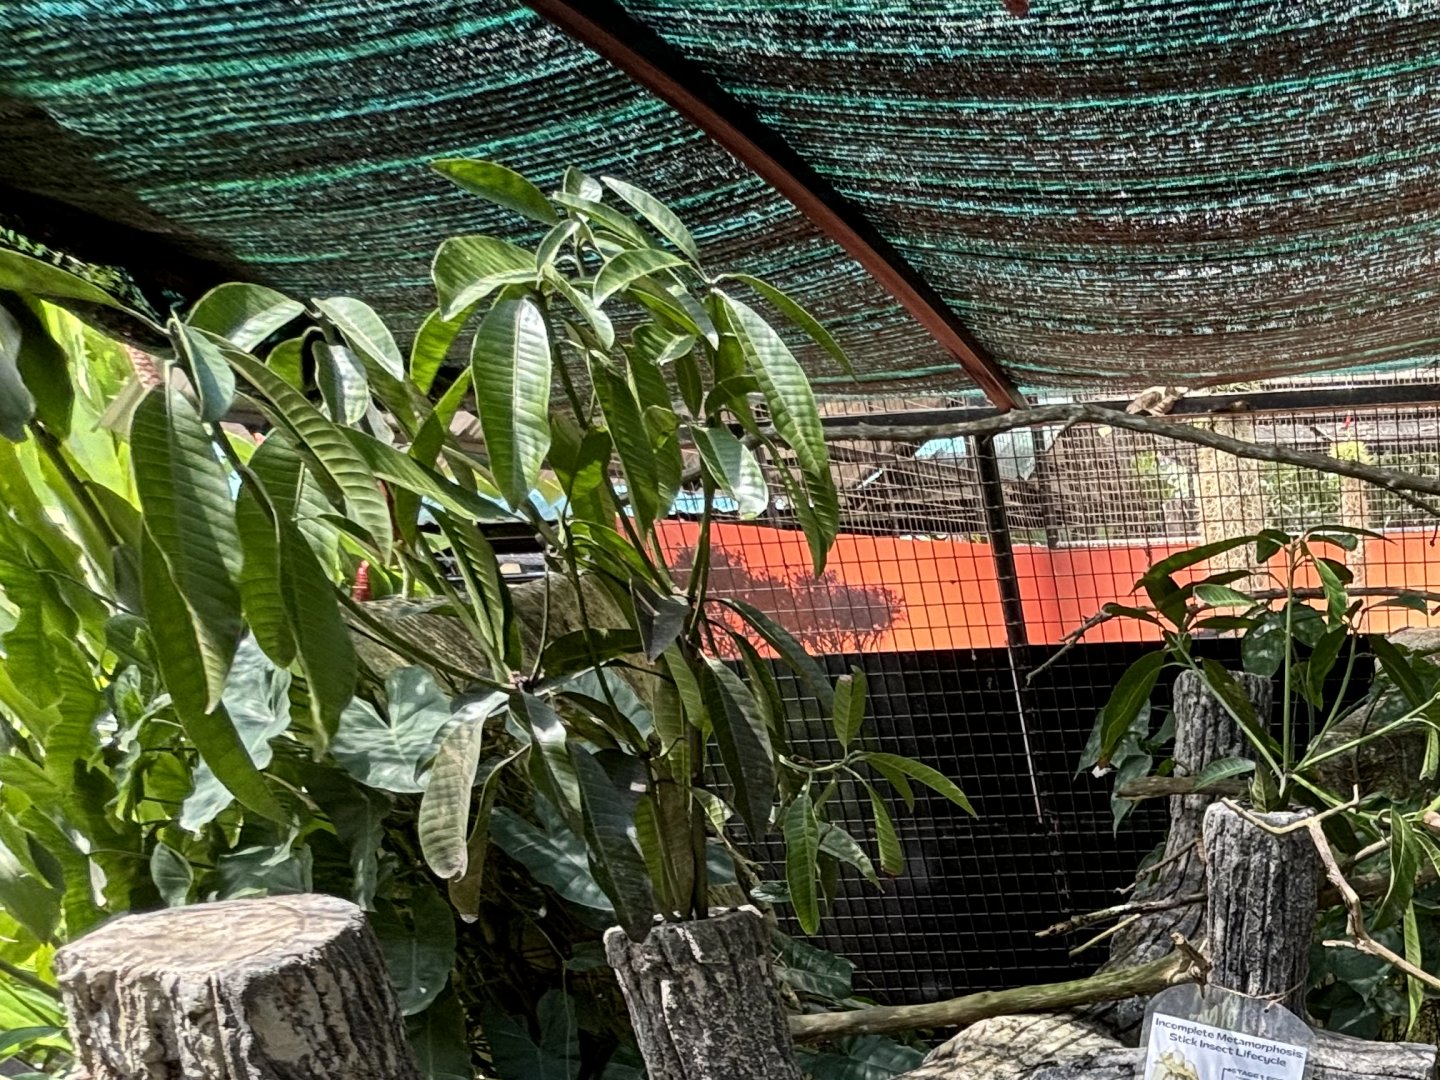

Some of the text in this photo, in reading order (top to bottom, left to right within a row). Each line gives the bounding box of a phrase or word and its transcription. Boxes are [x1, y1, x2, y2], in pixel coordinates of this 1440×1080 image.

[1155, 1017, 1304, 1059] Incomplete Metamorphosis
[1169, 1032, 1287, 1067] Stick Insect Lifecycle
[1231, 1068, 1260, 1080] STAGE
